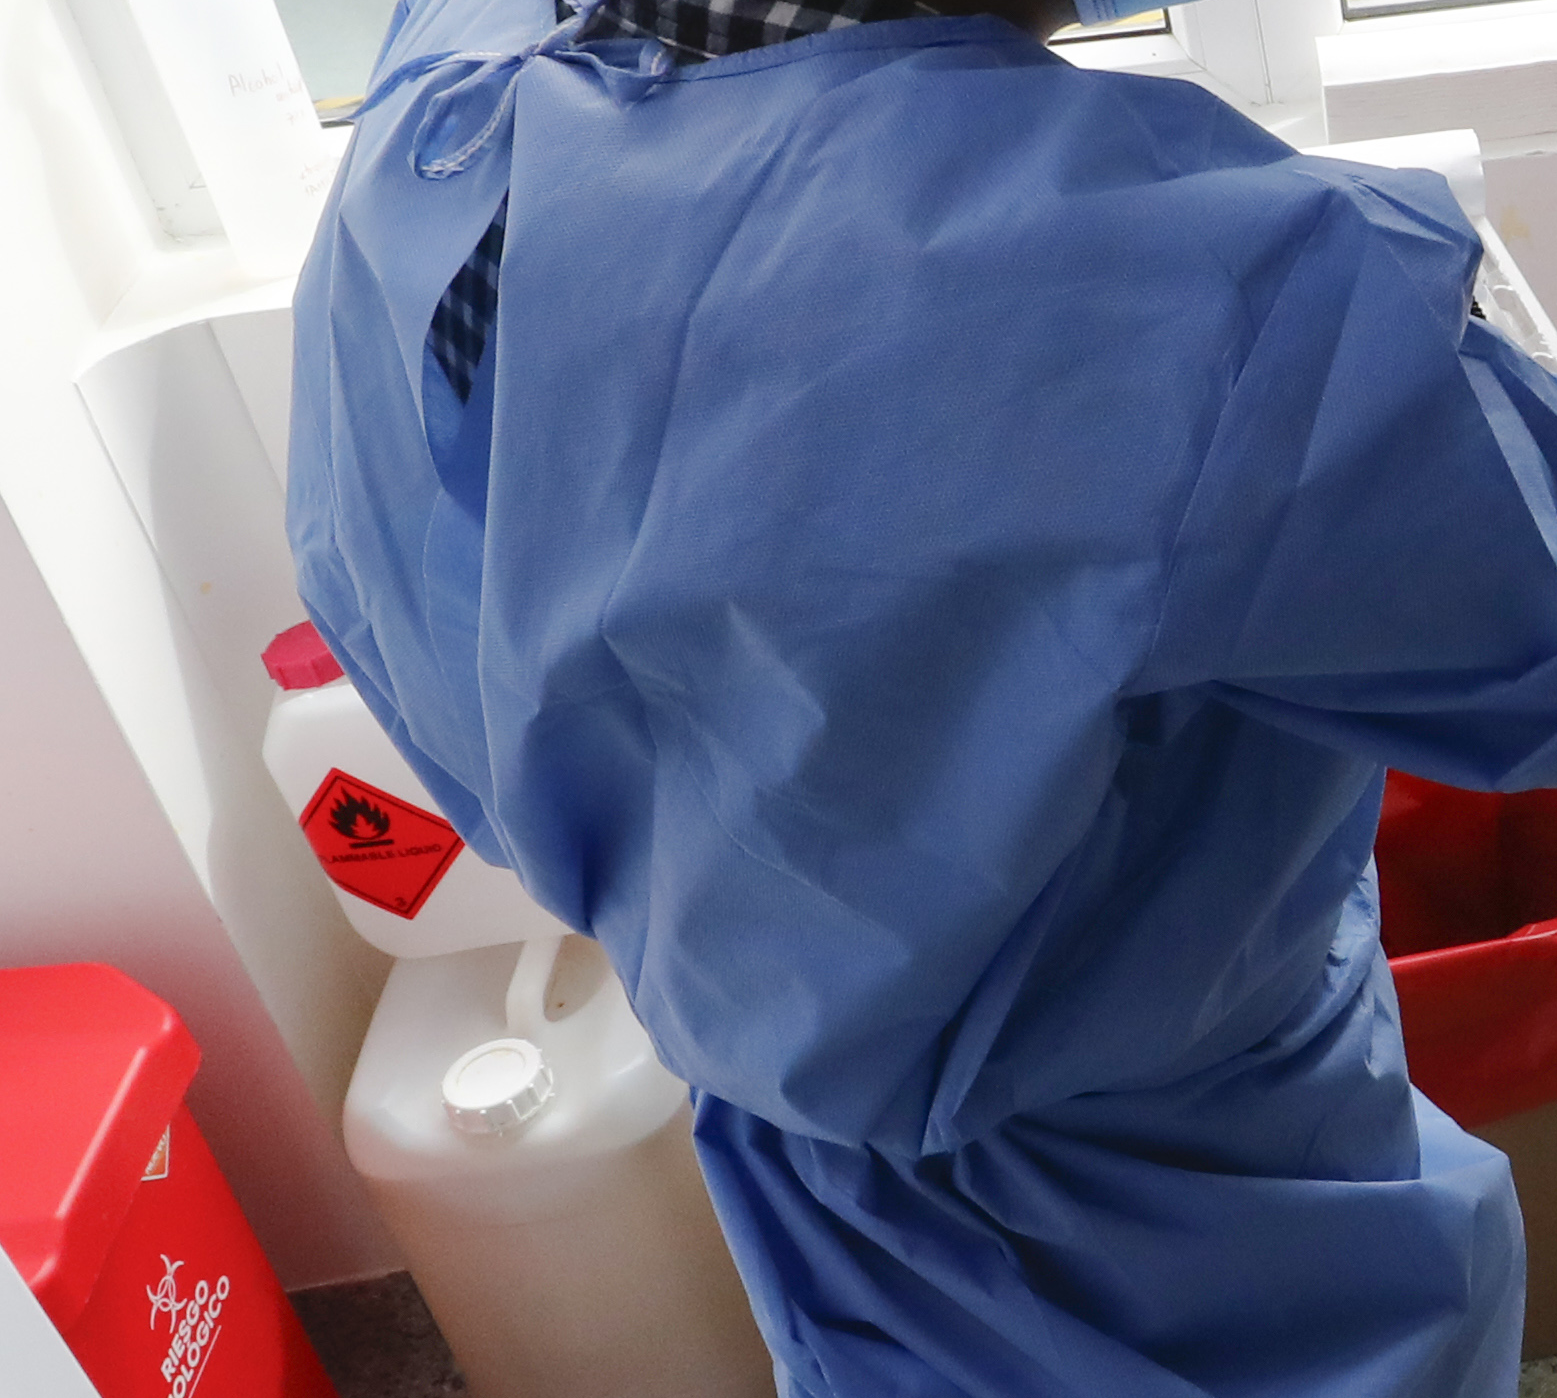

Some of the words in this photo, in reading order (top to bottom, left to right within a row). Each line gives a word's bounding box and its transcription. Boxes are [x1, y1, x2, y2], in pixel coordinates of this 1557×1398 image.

[227, 60, 285, 98] Alcohol
[398, 843, 443, 858] LIQUID
[160, 1279, 210, 1383] RIESGO
[166, 1275, 230, 1398] OLÓGICO
